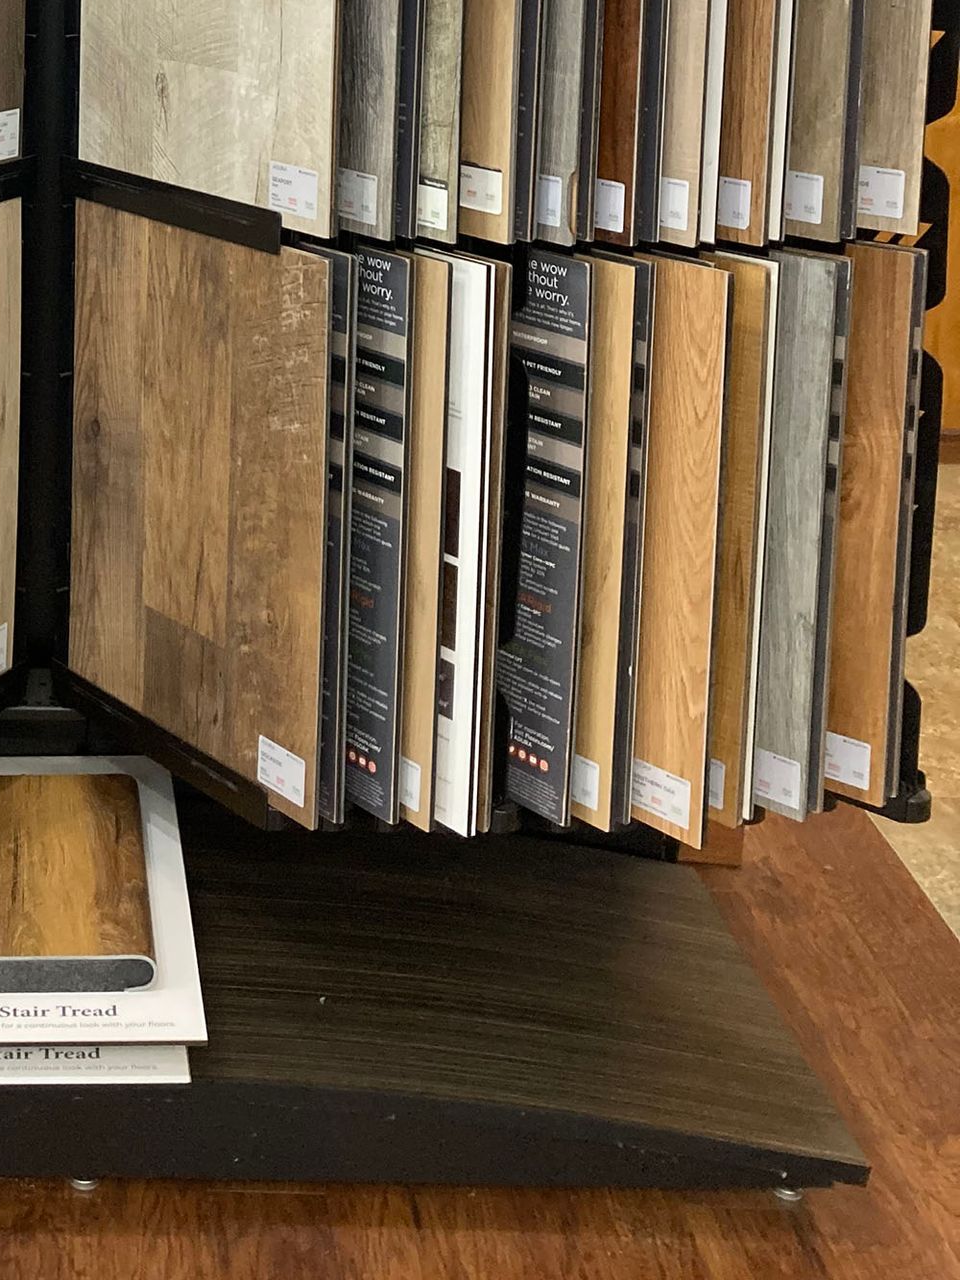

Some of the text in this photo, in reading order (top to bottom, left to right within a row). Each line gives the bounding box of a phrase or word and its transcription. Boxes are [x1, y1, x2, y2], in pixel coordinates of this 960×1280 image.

[367, 256, 391, 271] wow
[540, 261, 567, 277] wow
[359, 265, 383, 283] hout
[528, 270, 558, 289] thout
[362, 282, 393, 301] worry.
[535, 287, 570, 306] worry.
[361, 359, 386, 372] FRIENDLY
[536, 363, 562, 376] FRIENDLY
[533, 386, 551, 397] CLEAN
[360, 411, 386, 426] RESISTANT
[534, 414, 562, 429] RESISTANT
[368, 465, 395, 483] RESISTANT
[526, 465, 571, 486] ATION RESISTANT
[530, 492, 560, 509] WARRANTY
[0, 1005, 50, 1018] Stair
[56, 1004, 118, 1017] Tread
[39, 1047, 101, 1060] Tread
